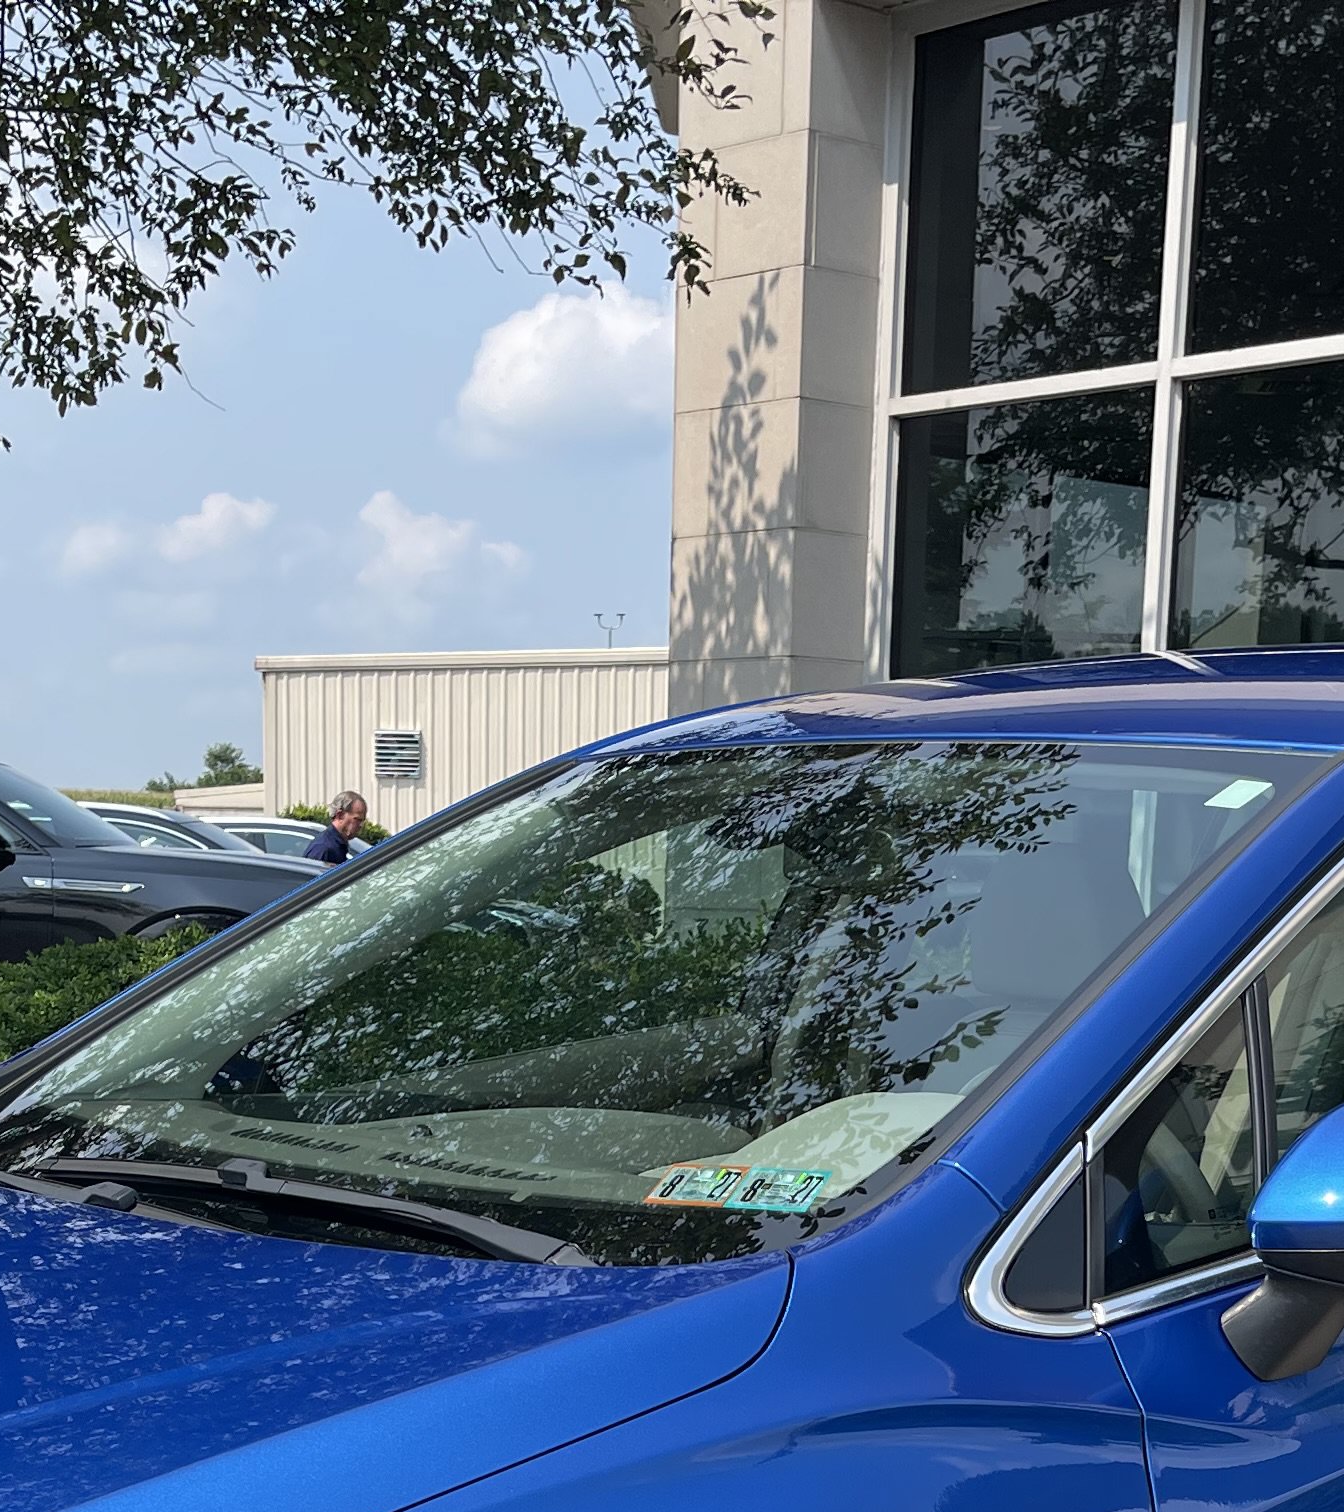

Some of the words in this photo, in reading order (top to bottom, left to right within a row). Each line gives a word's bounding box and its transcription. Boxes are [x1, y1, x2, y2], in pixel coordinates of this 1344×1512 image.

[659, 1174, 685, 1198] 8
[707, 1171, 742, 1201] 27
[740, 1178, 766, 1202] 8
